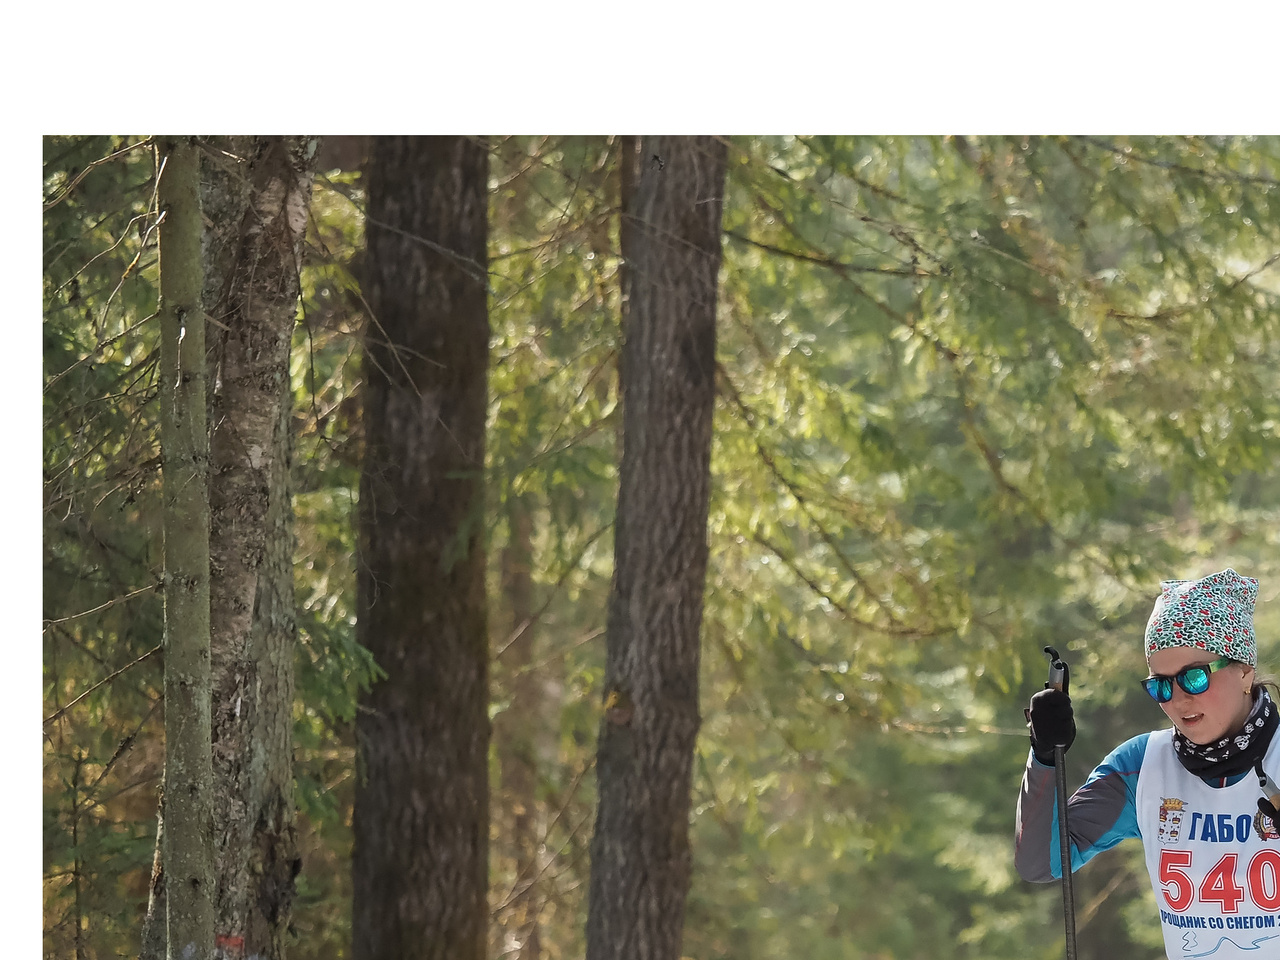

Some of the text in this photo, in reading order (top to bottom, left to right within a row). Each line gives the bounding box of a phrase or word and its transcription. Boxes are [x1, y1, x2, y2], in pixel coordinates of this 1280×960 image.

[1188, 812, 1252, 843] ГАБО
[1208, 916, 1224, 929] СО
[1226, 915, 1275, 929] СНЕГОМ
